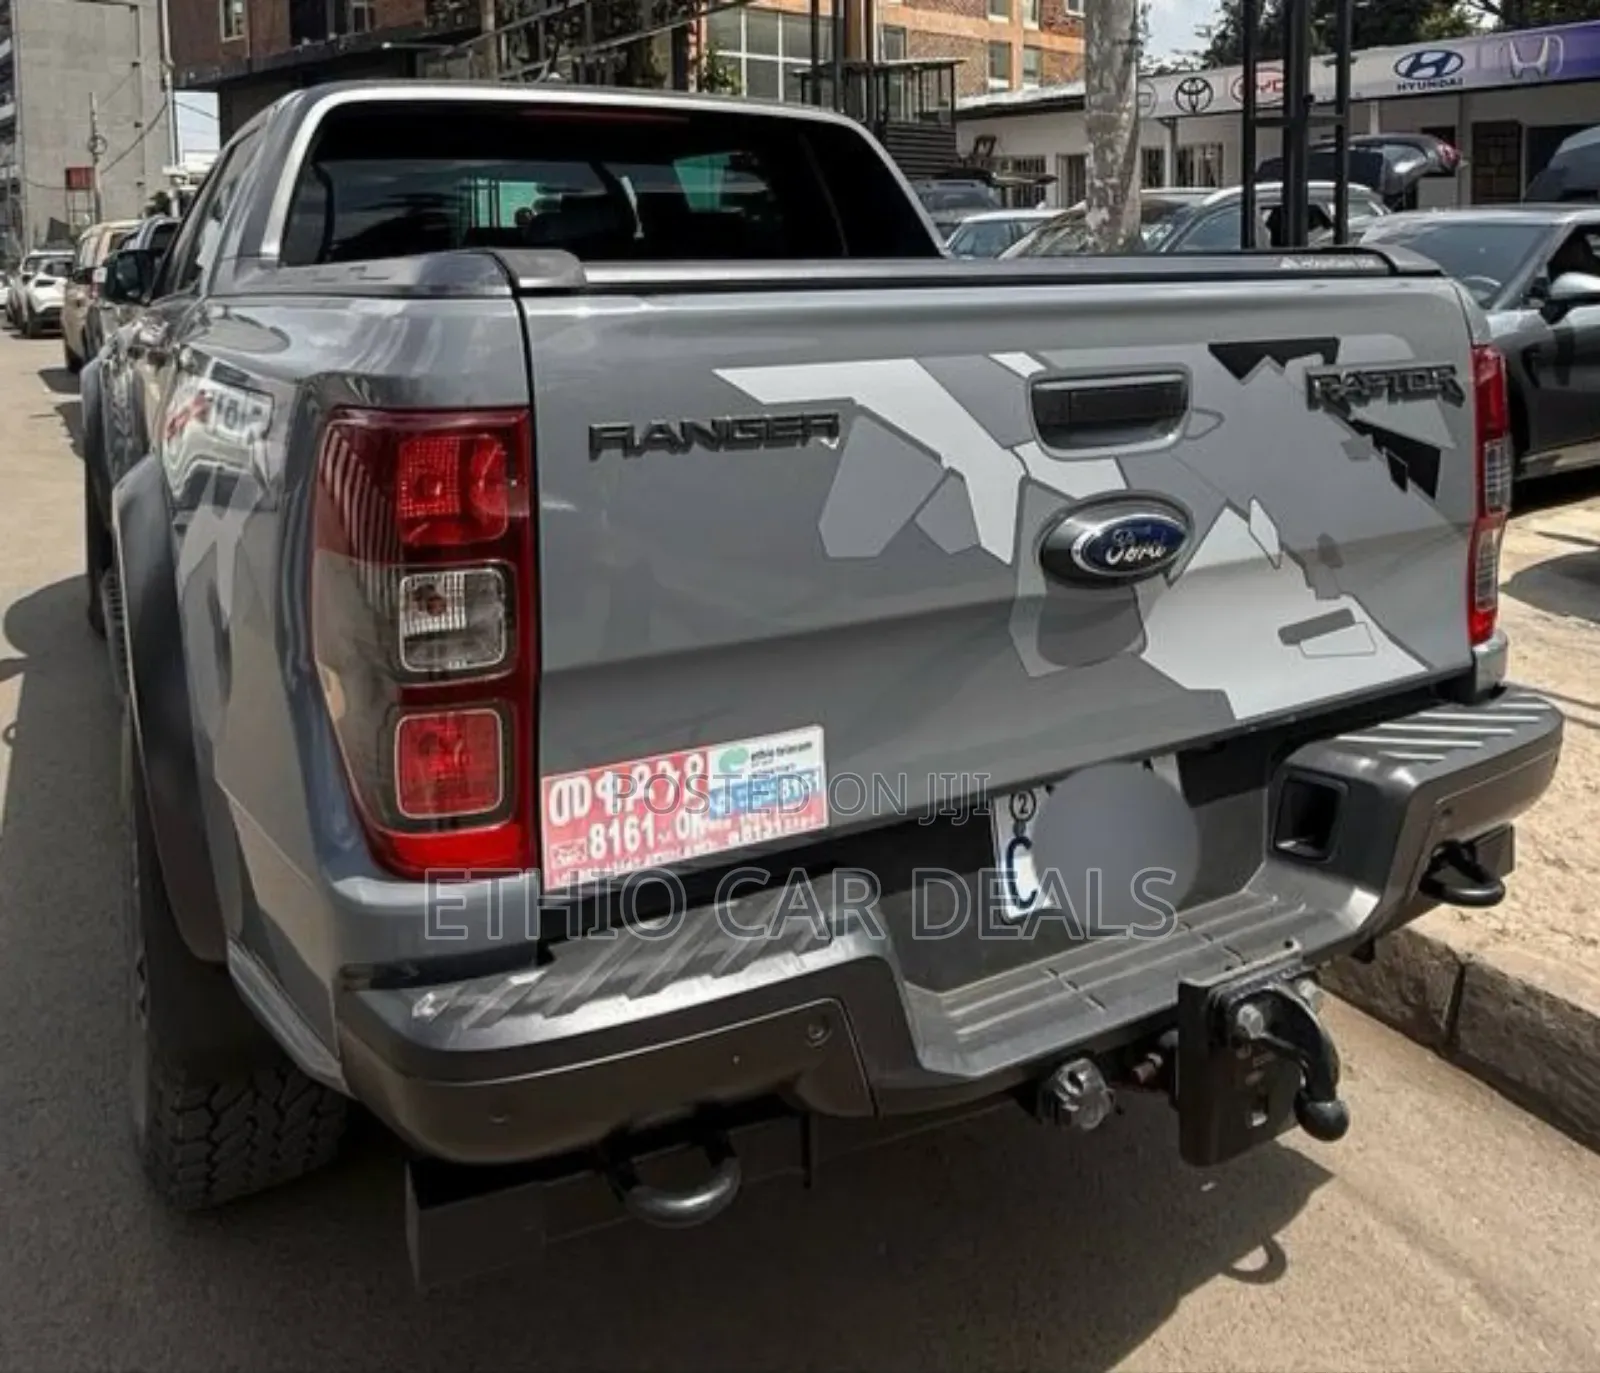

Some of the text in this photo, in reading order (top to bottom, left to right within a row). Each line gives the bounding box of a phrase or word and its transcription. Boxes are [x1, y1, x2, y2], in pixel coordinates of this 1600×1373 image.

[1396, 77, 1464, 92] HYUNDAI
[1306, 364, 1466, 411] RAPTOR
[589, 413, 839, 462] RANGER
[1104, 528, 1167, 566] Ford
[1017, 793, 1029, 815] 2
[588, 812, 656, 861] 8161
